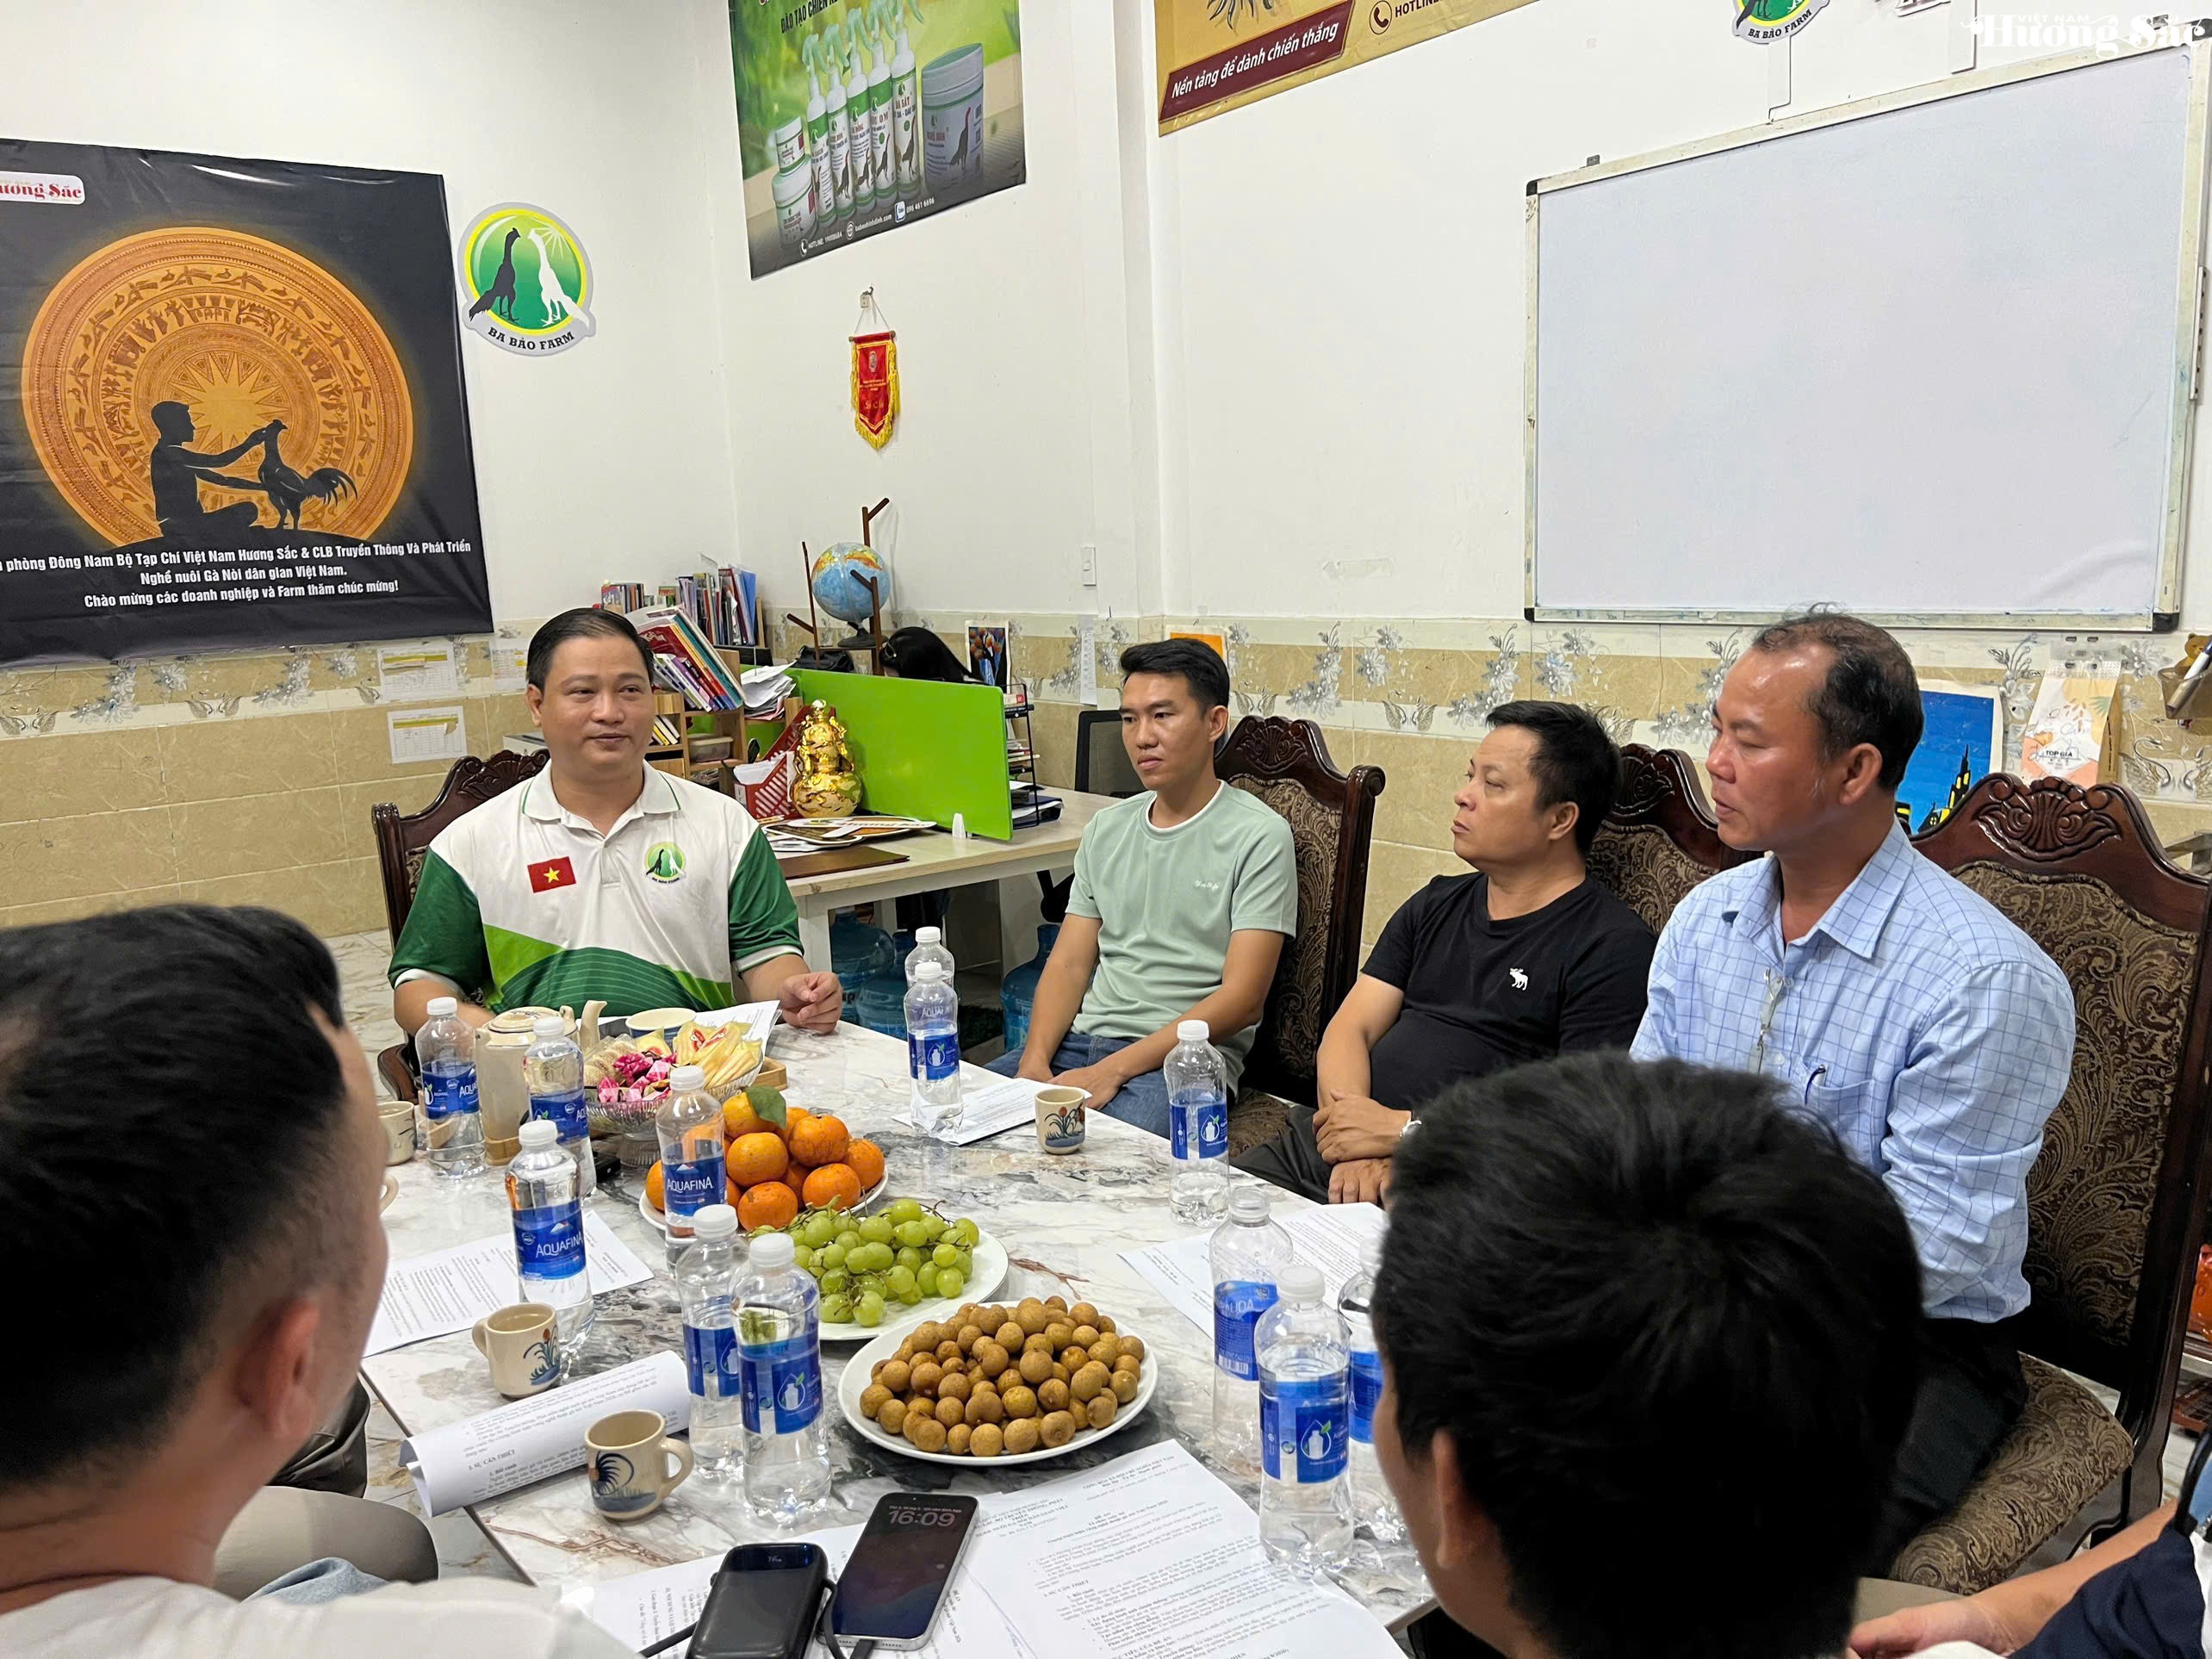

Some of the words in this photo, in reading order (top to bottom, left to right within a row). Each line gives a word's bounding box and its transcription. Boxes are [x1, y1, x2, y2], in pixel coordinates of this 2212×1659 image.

[794, 4, 807, 27] TẠO
[1395, 0, 1440, 17] HOTLI
[1747, 28, 1760, 40] BA
[1784, 9, 1812, 34] FARM
[1194, 70, 1220, 88] tảng
[1221, 55, 1239, 79] để
[1236, 52, 1265, 73] dành
[1267, 33, 1299, 61] chiến
[1302, 20, 1339, 49] thắng
[488, 326, 506, 343] BA
[508, 337, 536, 351] BẢO
[538, 331, 575, 351] FARM
[6, 557, 46, 573] phòng
[48, 556, 82, 571] Đông
[84, 554, 114, 569] Nam
[116, 552, 133, 569] Bộ
[134, 553, 158, 567] Tạp
[160, 550, 181, 564] Chí
[183, 550, 207, 566] Việt
[208, 550, 236, 562] Nam
[239, 549, 274, 562] Hương
[276, 544, 298, 560] Sắc
[301, 548, 310, 559] &
[313, 546, 334, 558] CLB
[335, 543, 371, 558] Truyền
[373, 544, 405, 556] Thông
[406, 543, 419, 555] Và
[422, 541, 445, 554] Phát
[445, 538, 472, 553] Triển
[140, 569, 172, 587] Nghề
[175, 569, 202, 584] nuôi
[203, 568, 220, 582] Gà
[222, 568, 242, 581] Nòi
[245, 567, 266, 581] dân
[269, 567, 294, 581] gian
[295, 565, 317, 581] Việt
[318, 564, 348, 577] Nam.
[84, 593, 116, 608] Chào
[119, 592, 153, 606] mừng
[156, 590, 179, 604] các
[182, 589, 217, 602] doanh
[220, 587, 259, 602] nghiệp
[262, 587, 276, 599] và
[277, 585, 306, 598] Farm
[308, 581, 335, 596] thăm
[337, 581, 363, 594] chúc
[366, 580, 399, 593] mừng!
[667, 1176, 714, 1194] AQUAFINA
[536, 1231, 584, 1258] AQUAFINA
[888, 1509, 955, 1527] 16:09
